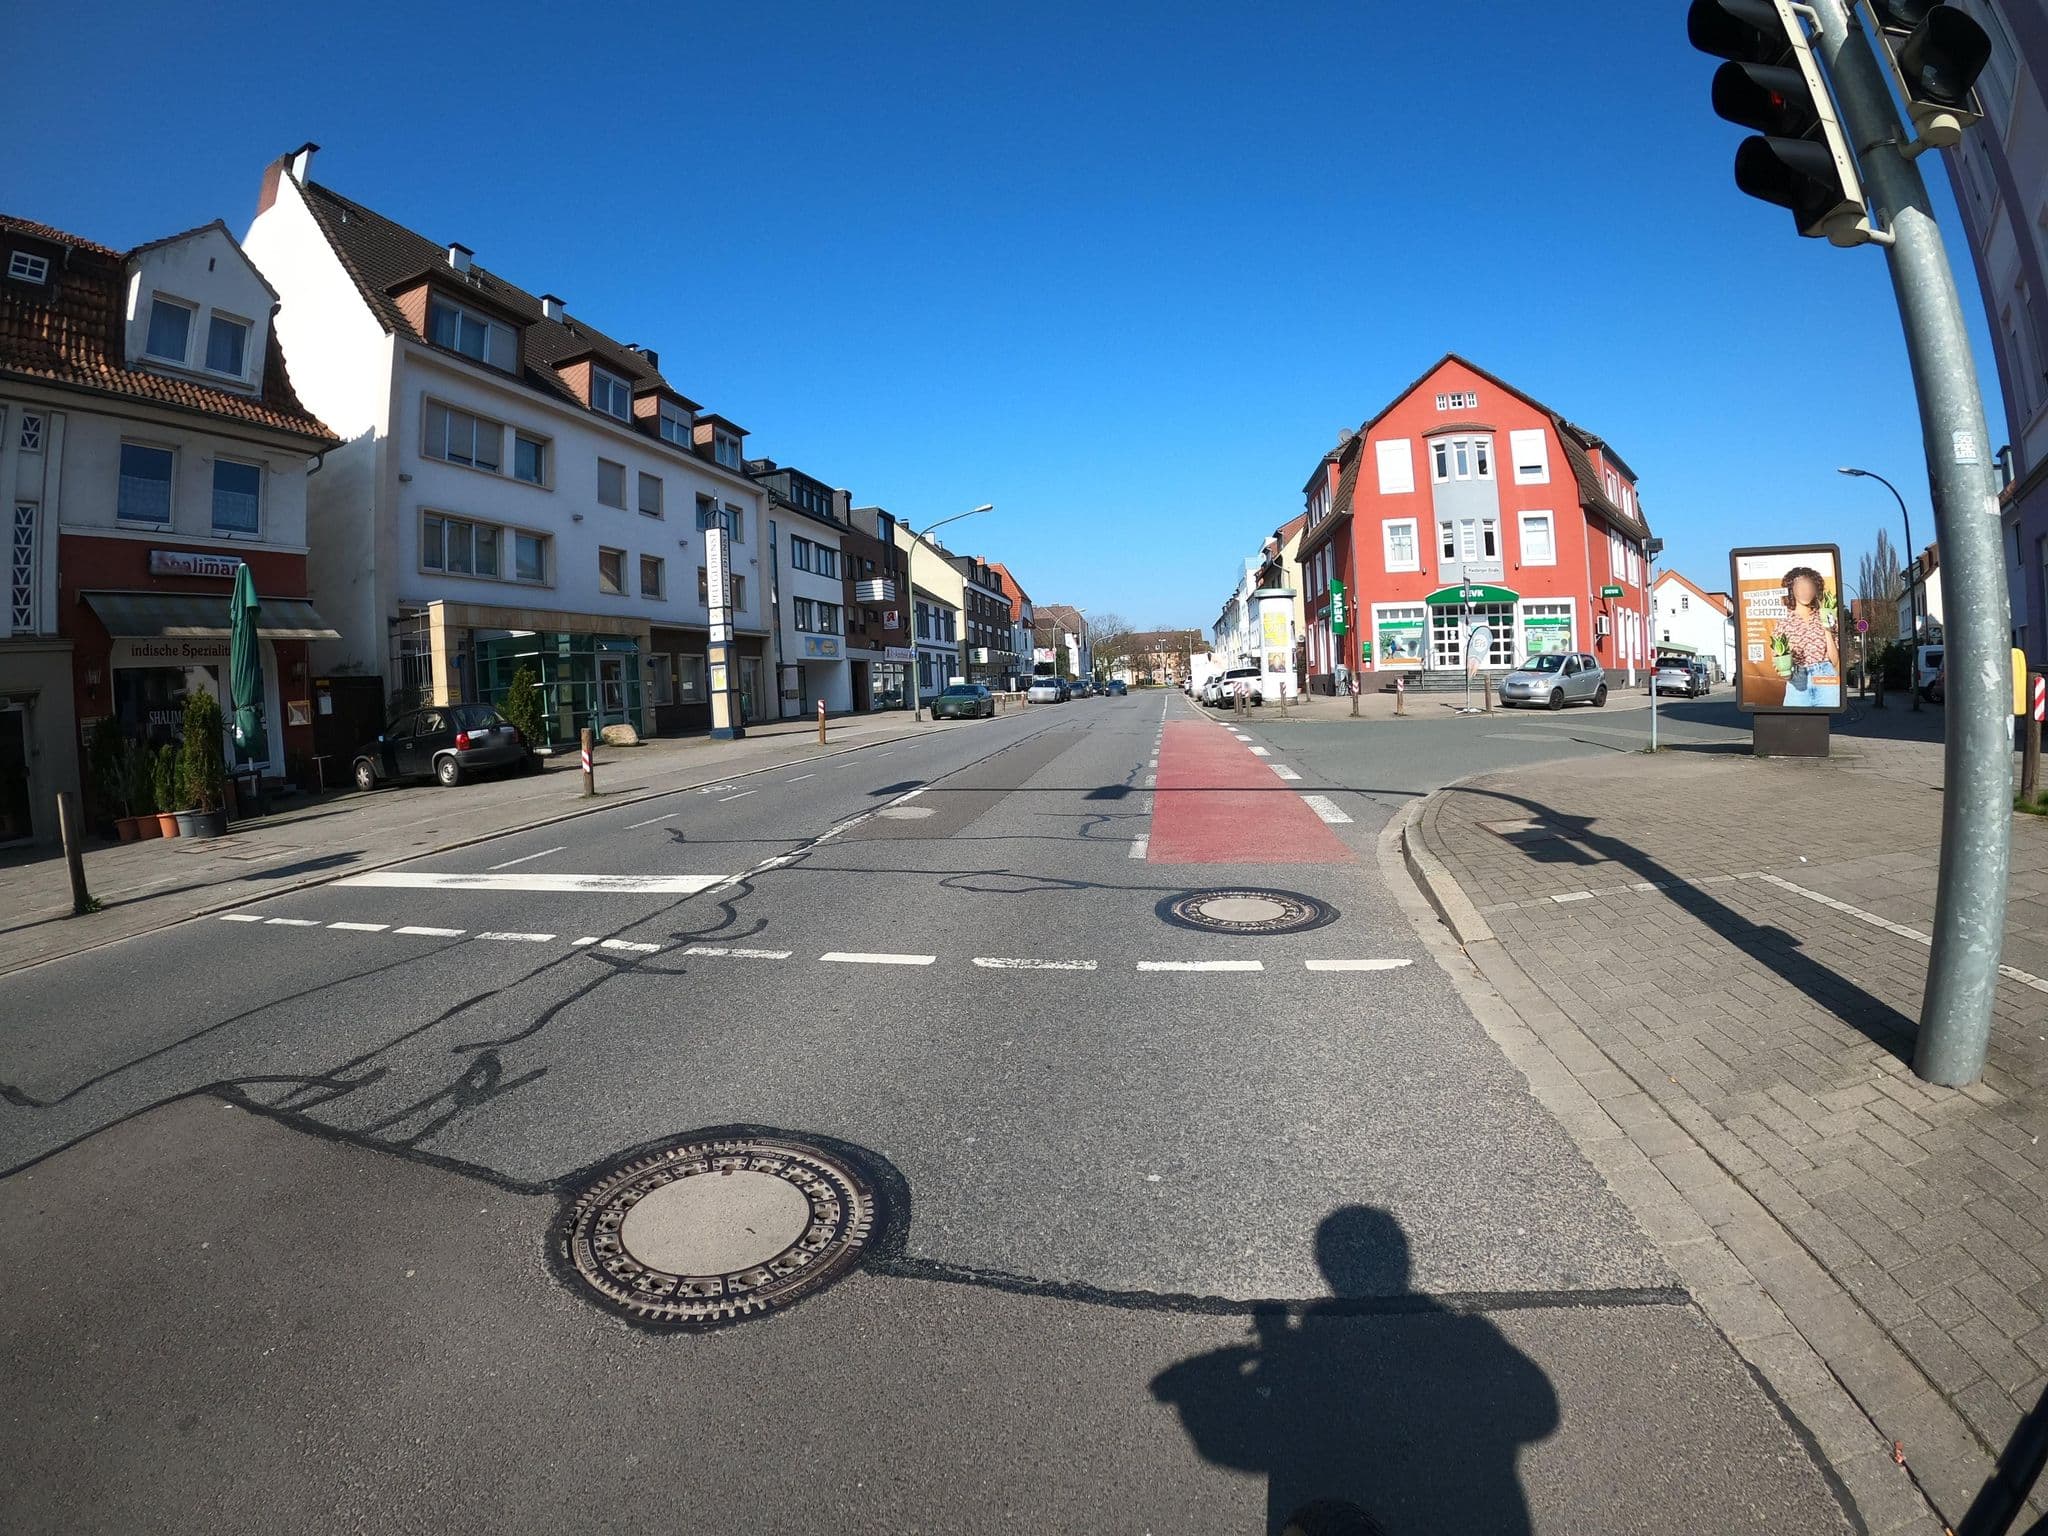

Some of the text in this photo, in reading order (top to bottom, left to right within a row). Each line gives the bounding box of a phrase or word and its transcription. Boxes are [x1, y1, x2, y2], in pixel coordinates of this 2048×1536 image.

[158, 556, 238, 576] alimar
[1332, 593, 1344, 623] DEVK
[1752, 598, 1780, 607] MOOR
[1748, 608, 1786, 617] SCHUTZ!
[131, 642, 231, 658] indische Spezialit
[149, 710, 182, 725] SHALIM
